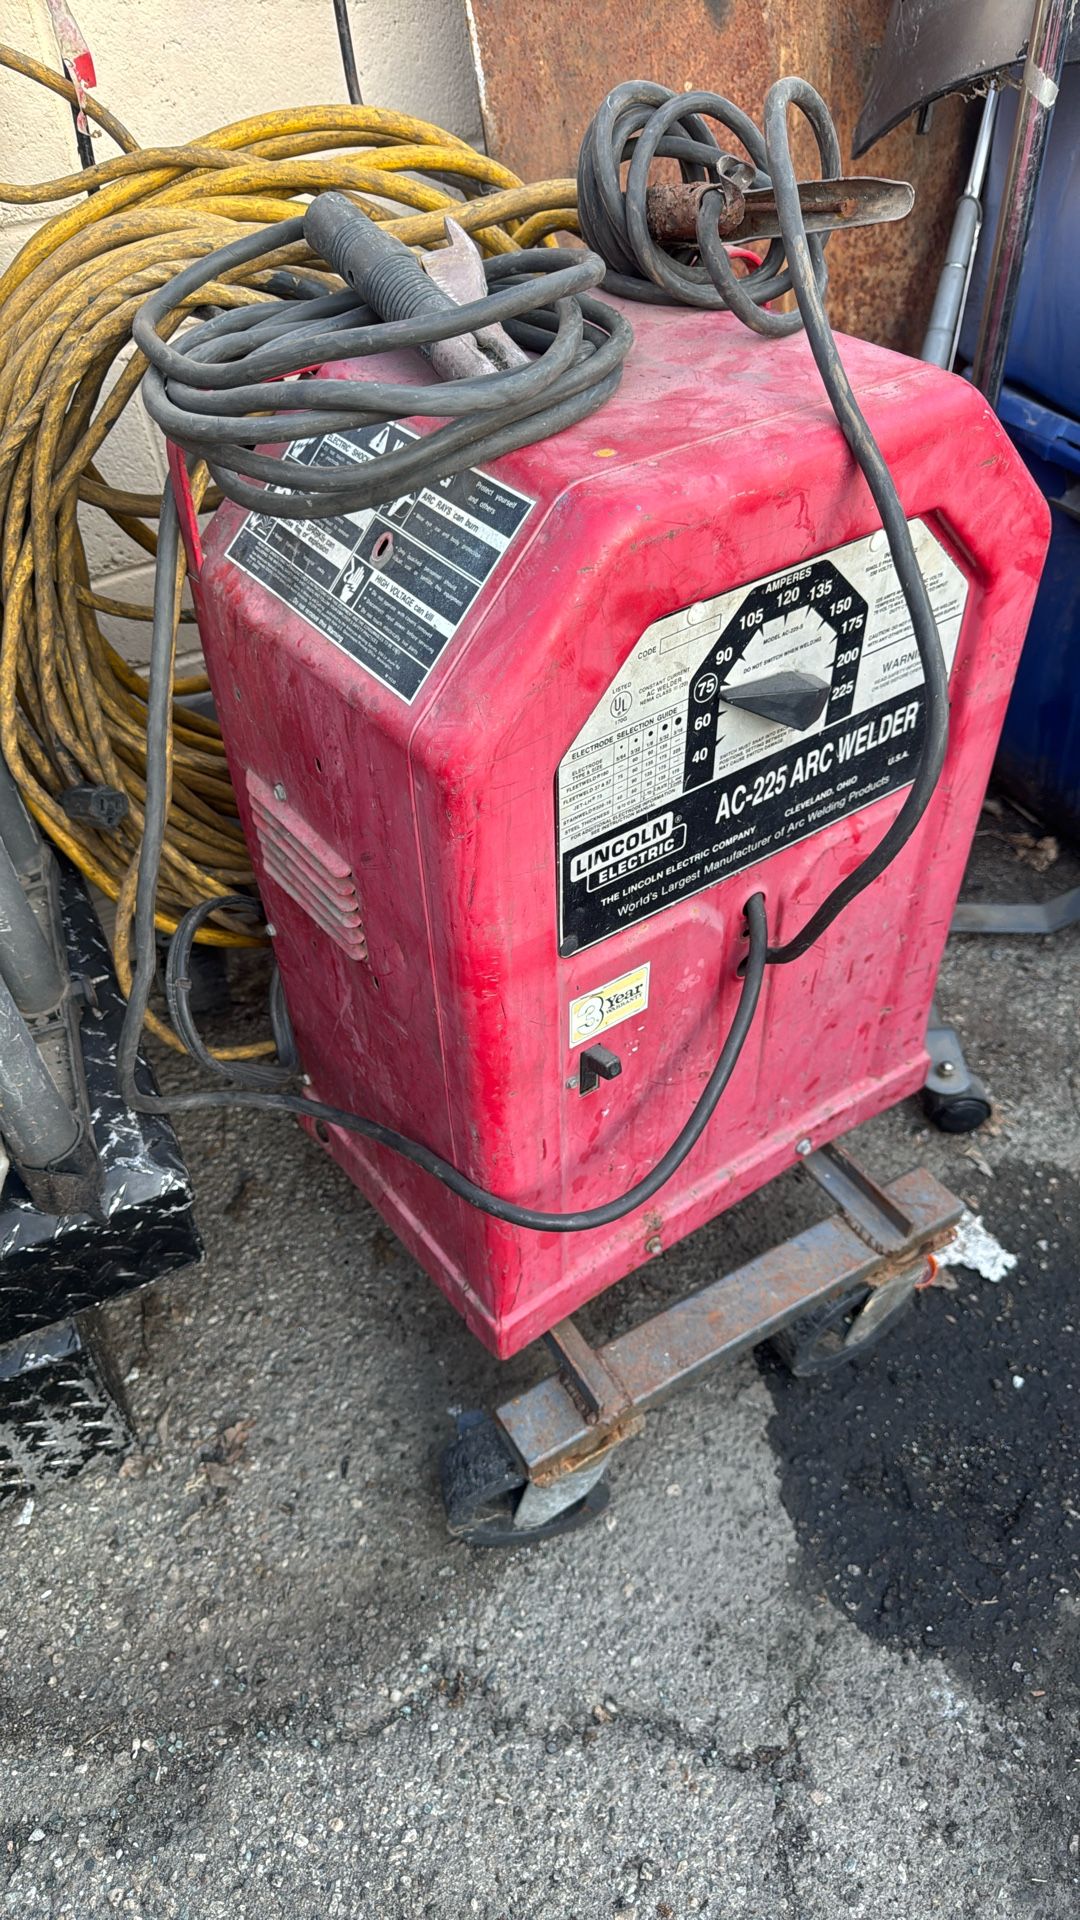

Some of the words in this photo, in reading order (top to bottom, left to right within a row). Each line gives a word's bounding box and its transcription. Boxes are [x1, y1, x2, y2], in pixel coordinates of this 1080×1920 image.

[326, 433, 351, 452] ELECTRIC
[467, 493, 479, 504] and
[478, 500, 497, 515] others
[474, 480, 495, 496] Protect
[494, 492, 517, 510] yourself
[421, 491, 436, 504] ARC
[434, 500, 453, 515] RAYS
[452, 512, 464, 523] can
[464, 519, 480, 532] burn
[307, 535, 329, 554] explosion
[324, 539, 335, 549] can
[765, 566, 812, 593] AMPERES
[809, 578, 833, 601] 135
[374, 574, 390, 589] HIGH
[388, 585, 414, 607] VOLTAGE
[413, 603, 425, 615] can
[423, 610, 434, 622] kill
[776, 586, 800, 608] 120
[828, 595, 852, 618] 150
[291, 596, 299, 605] Do
[297, 602, 305, 610] not
[303, 607, 319, 622] remove
[318, 618, 327, 628] this
[325, 625, 344, 643] Warning
[738, 608, 763, 631] 105
[840, 613, 864, 635] 175
[763, 633, 780, 644] MODEL
[637, 645, 656, 660] CODE
[715, 646, 732, 665] 90
[743, 666, 751, 674] DO
[752, 661, 762, 670] NOT
[763, 652, 782, 665] SWITCH
[784, 645, 798, 656] WHEN
[836, 646, 859, 667] 200
[880, 648, 918, 674] WARNI
[612, 681, 631, 694] LISTED
[638, 677, 665, 694] CONSTANT
[666, 666, 689, 682] CURRENT
[646, 688, 655, 697] AC
[656, 676, 681, 693] WELDER
[698, 677, 715, 697] 75
[831, 679, 854, 700] 225
[614, 694, 627, 715] UL
[639, 695, 654, 706] NEMA
[655, 688, 670, 699] CLASS
[571, 736, 613, 759] ELECTRODE
[616, 717, 654, 740] SELECTION
[657, 706, 677, 722] GUIDE
[694, 712, 711, 731] 60
[691, 746, 708, 765] 40
[715, 763, 788, 825] AC-225
[789, 739, 836, 789] ARC
[833, 698, 921, 766] WELDER
[887, 748, 910, 766] U.S.A.
[572, 758, 602, 776] ELECTRODE
[572, 771, 585, 781] TYPE
[592, 763, 602, 772] SIZE
[783, 785, 834, 819] CLEVELAND,
[835, 773, 858, 792] OHIO
[617, 888, 657, 918] World's
[661, 868, 700, 898] Largest
[703, 832, 771, 875] Manufacturer
[773, 825, 785, 840] of
[786, 816, 805, 833] Arc
[806, 794, 846, 824] Welding
[847, 772, 891, 803] Products
[599, 836, 674, 884] ELECTRIC
[601, 891, 619, 907] THE
[622, 870, 663, 896] LINCOLN
[665, 847, 709, 876] ELECTRIC
[712, 824, 755, 853] COMPANY
[605, 984, 643, 1009] Year
